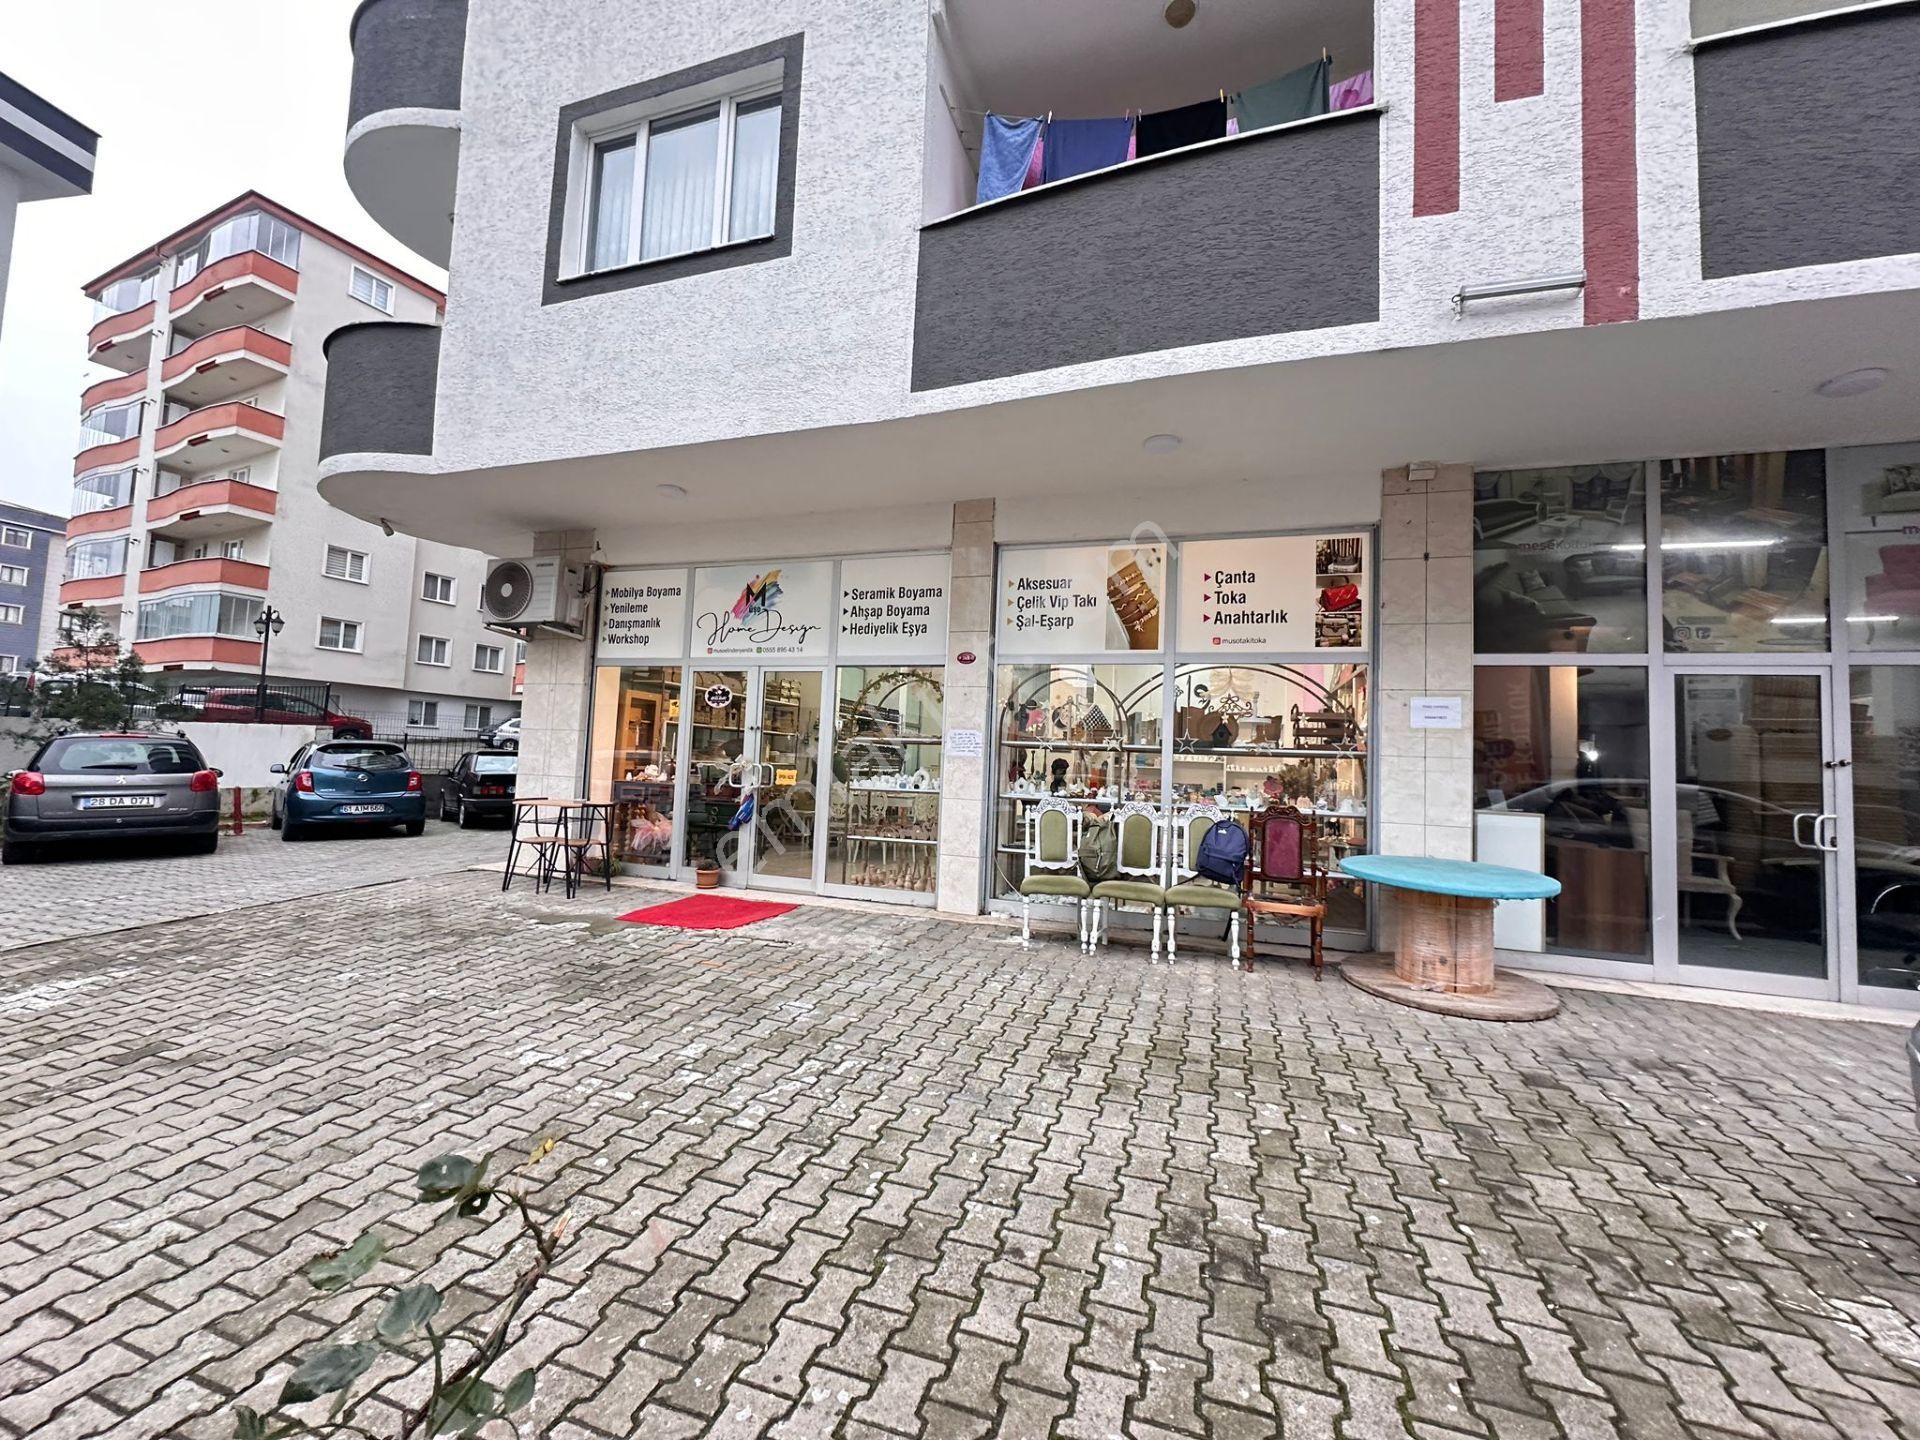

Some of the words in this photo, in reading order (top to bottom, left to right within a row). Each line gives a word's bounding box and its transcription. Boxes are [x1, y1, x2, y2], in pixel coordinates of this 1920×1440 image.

[1017, 577, 1073, 590] Aksesuar
[1214, 570, 1256, 588] Çanta
[610, 587, 644, 600] Mobilya
[646, 586, 682, 599] Boyama
[851, 587, 896, 600] Seramik
[898, 586, 943, 600] Boyama
[1214, 590, 1247, 604] Toka
[610, 602, 648, 614] Yenileme
[1016, 595, 1046, 612] Çelik
[1050, 595, 1069, 611] Vip
[1072, 594, 1097, 607] Takı
[850, 605, 883, 620] Ahşap
[886, 604, 930, 619] Boyama
[1213, 609, 1288, 625] Anahtarlık
[608, 617, 661, 631] Danışmanlık
[697, 611, 757, 646] Home
[749, 608, 821, 645] Design
[850, 622, 899, 637] Hediyelik
[902, 621, 928, 637] Eşya
[1016, 614, 1074, 632] Şal-Eşarp
[607, 633, 650, 646] Workshop
[91, 798, 105, 806] 28
[109, 797, 125, 805] DA
[131, 797, 150, 805] 071
